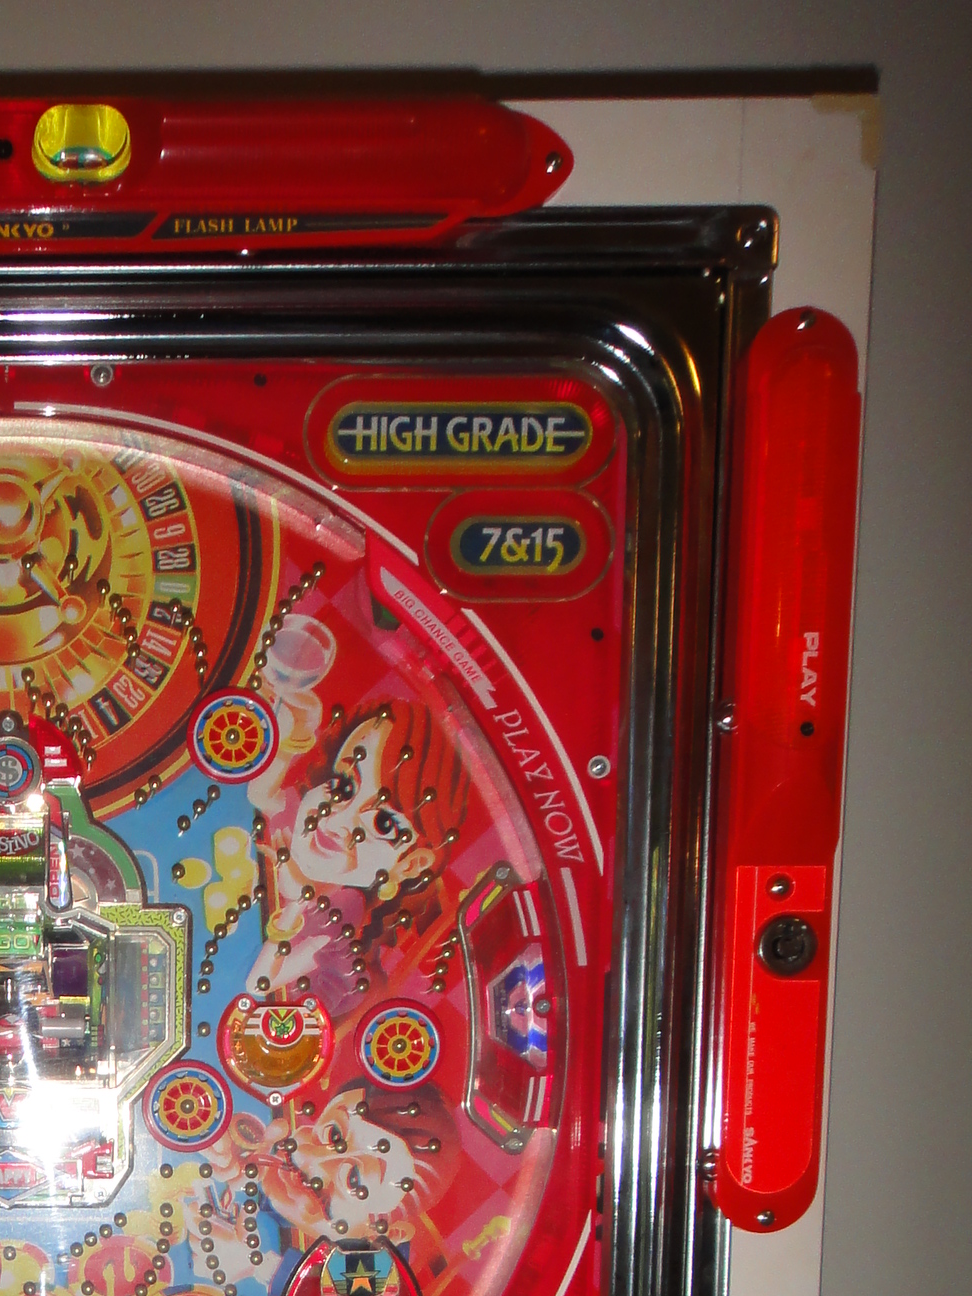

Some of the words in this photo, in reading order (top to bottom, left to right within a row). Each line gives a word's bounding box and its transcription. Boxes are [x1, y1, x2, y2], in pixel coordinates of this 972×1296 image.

[174, 218, 234, 233] FLASH
[245, 217, 298, 232] LAMP
[338, 415, 438, 452] HIGH
[446, 416, 585, 453] GRADE
[479, 527, 564, 573] 7&15
[394, 590, 416, 609] BIG
[415, 608, 456, 651] CHANCE
[453, 651, 483, 684] GAME
[800, 632, 819, 707] PLAY
[492, 708, 554, 782] PLAY
[534, 790, 585, 864] NOW
[742, 1127, 758, 1184] SANKYO
